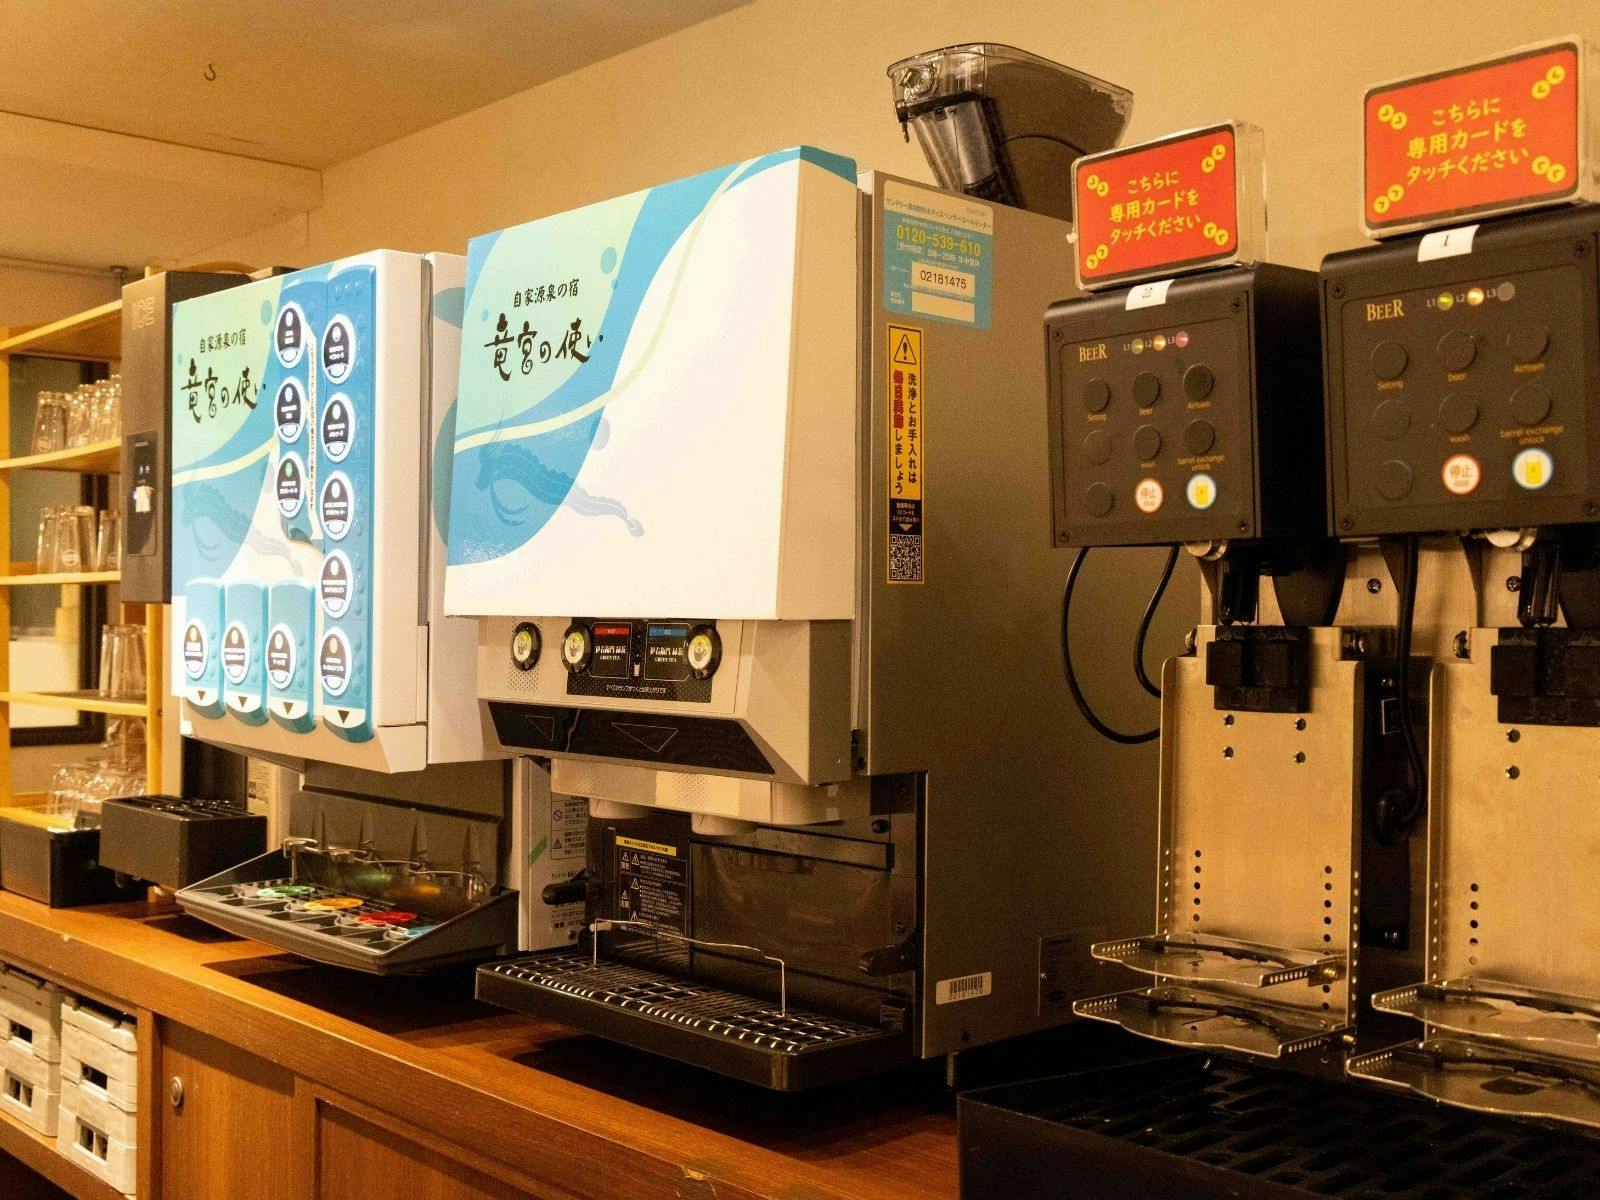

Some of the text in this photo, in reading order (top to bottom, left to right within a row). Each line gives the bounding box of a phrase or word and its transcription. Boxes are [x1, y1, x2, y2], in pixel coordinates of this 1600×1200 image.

[1431, 97, 1501, 127] こちらに
[1406, 118, 1527, 160] 専用カードを
[1406, 147, 1529, 186] タッチください
[1127, 171, 1179, 194] こちらに
[1109, 189, 1199, 223] 専用カードを
[896, 224, 981, 257] 0120-539-610
[1110, 214, 1201, 245] タッチください
[513, 278, 580, 308] 自家源泉の宿
[920, 270, 967, 290] 02181475
[1141, 286, 1154, 299] 2
[1366, 299, 1405, 321] BEER
[199, 328, 246, 354] 自家源泉の宿
[483, 312, 604, 381] 竜宮の使い
[1079, 343, 1108, 362] BEER
[180, 357, 267, 424] 竜宮の使い
[907, 372, 918, 484] 洗浄とお手入れは
